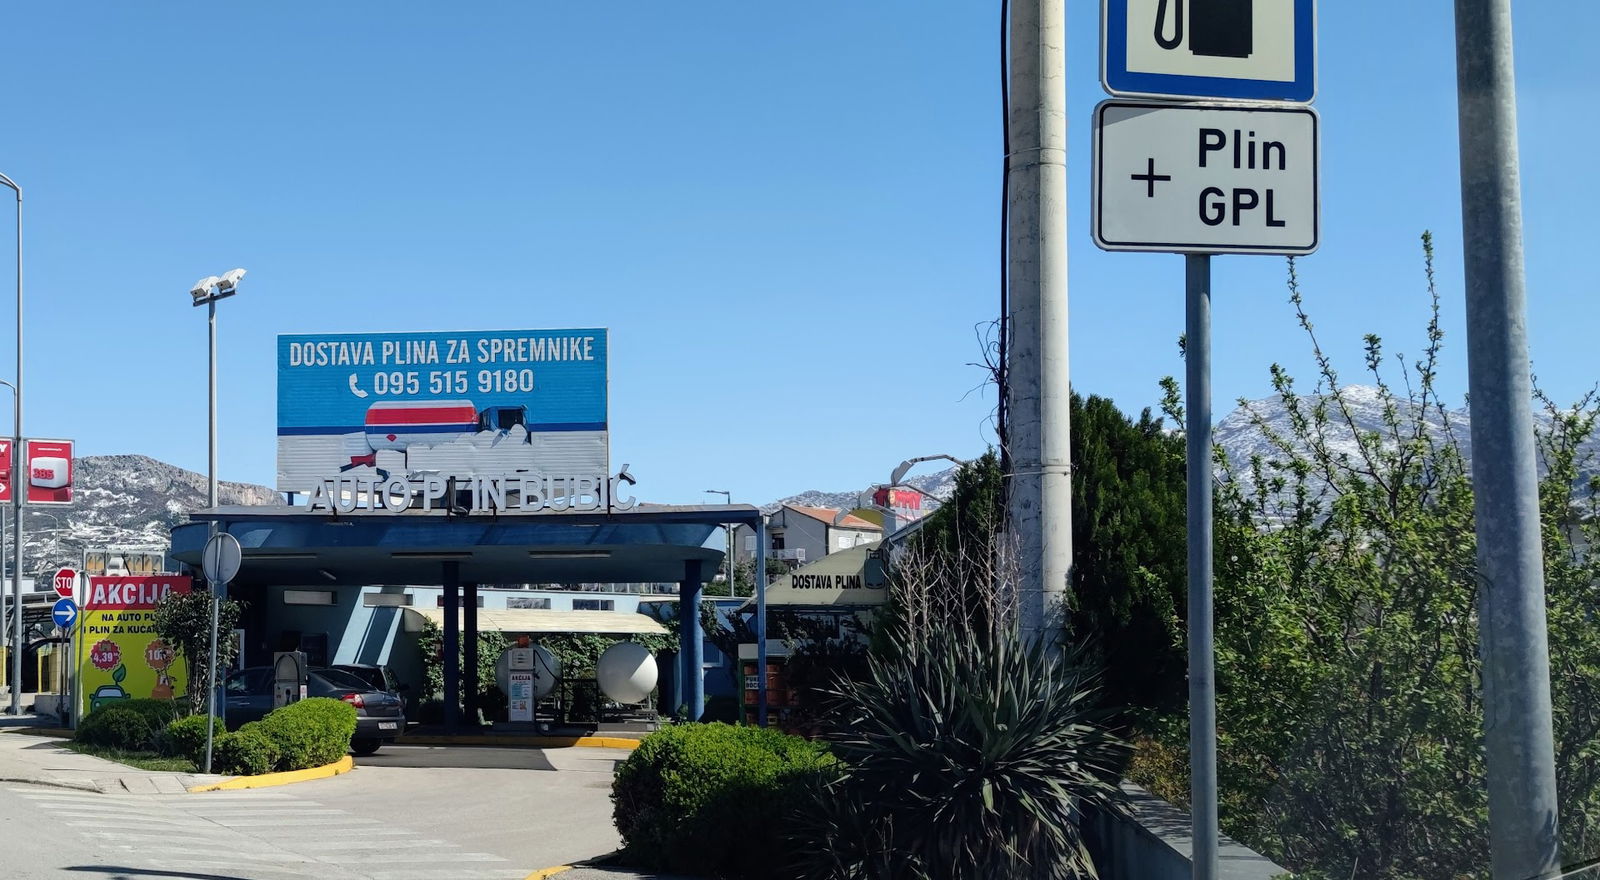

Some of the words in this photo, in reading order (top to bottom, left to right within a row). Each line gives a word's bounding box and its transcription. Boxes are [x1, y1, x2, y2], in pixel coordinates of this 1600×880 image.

[1198, 127, 1286, 170] Plin
[1198, 186, 1286, 227] GPL
[290, 341, 375, 366] DOSTAVA
[382, 340, 439, 365] PLINA
[446, 339, 471, 364] ZA
[477, 336, 594, 363] SPREMNIKE
[374, 371, 420, 395] 095
[429, 370, 468, 394] 515
[477, 369, 534, 393] 9180
[519, 464, 637, 512] BUBIĆ
[55, 576, 72, 589] STO
[792, 574, 832, 589] DOSTAVA
[835, 574, 862, 589] PLINA
[89, 625, 110, 634] PLIN
[113, 625, 125, 634] ZA
[102, 613, 114, 621] NA
[117, 613, 141, 621] AUTO
